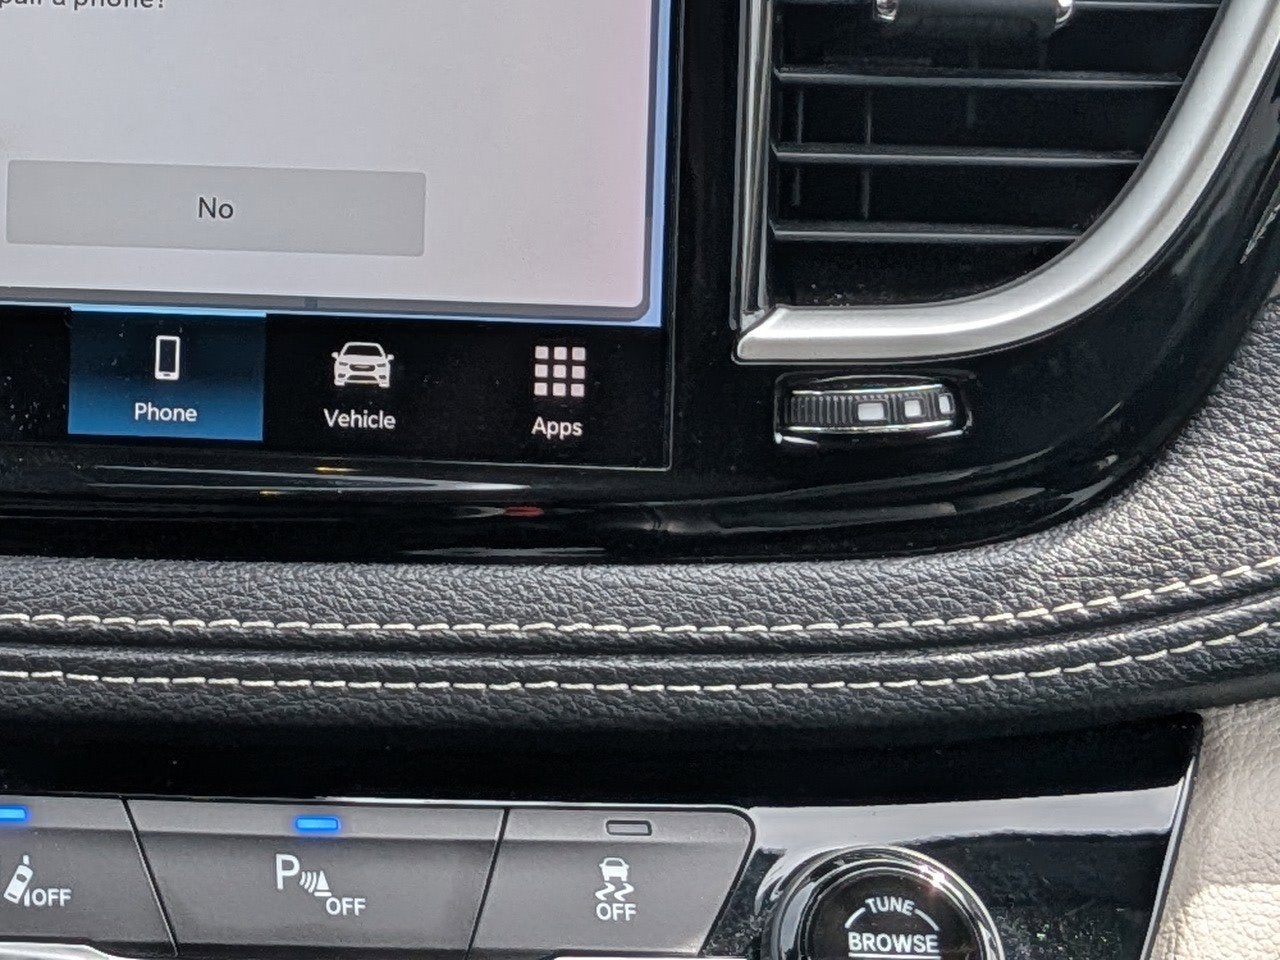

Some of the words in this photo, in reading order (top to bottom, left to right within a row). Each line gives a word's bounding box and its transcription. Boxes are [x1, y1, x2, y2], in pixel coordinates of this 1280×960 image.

[197, 197, 235, 221] No
[133, 402, 198, 424] Phone
[323, 408, 397, 431] Vehicle
[531, 416, 583, 438] Apps
[275, 853, 301, 890] P
[32, 888, 72, 907] OFF
[326, 897, 366, 916] OFF
[864, 895, 915, 917] TUNE
[596, 903, 637, 921] OFF
[848, 931, 940, 954] BROWSE
